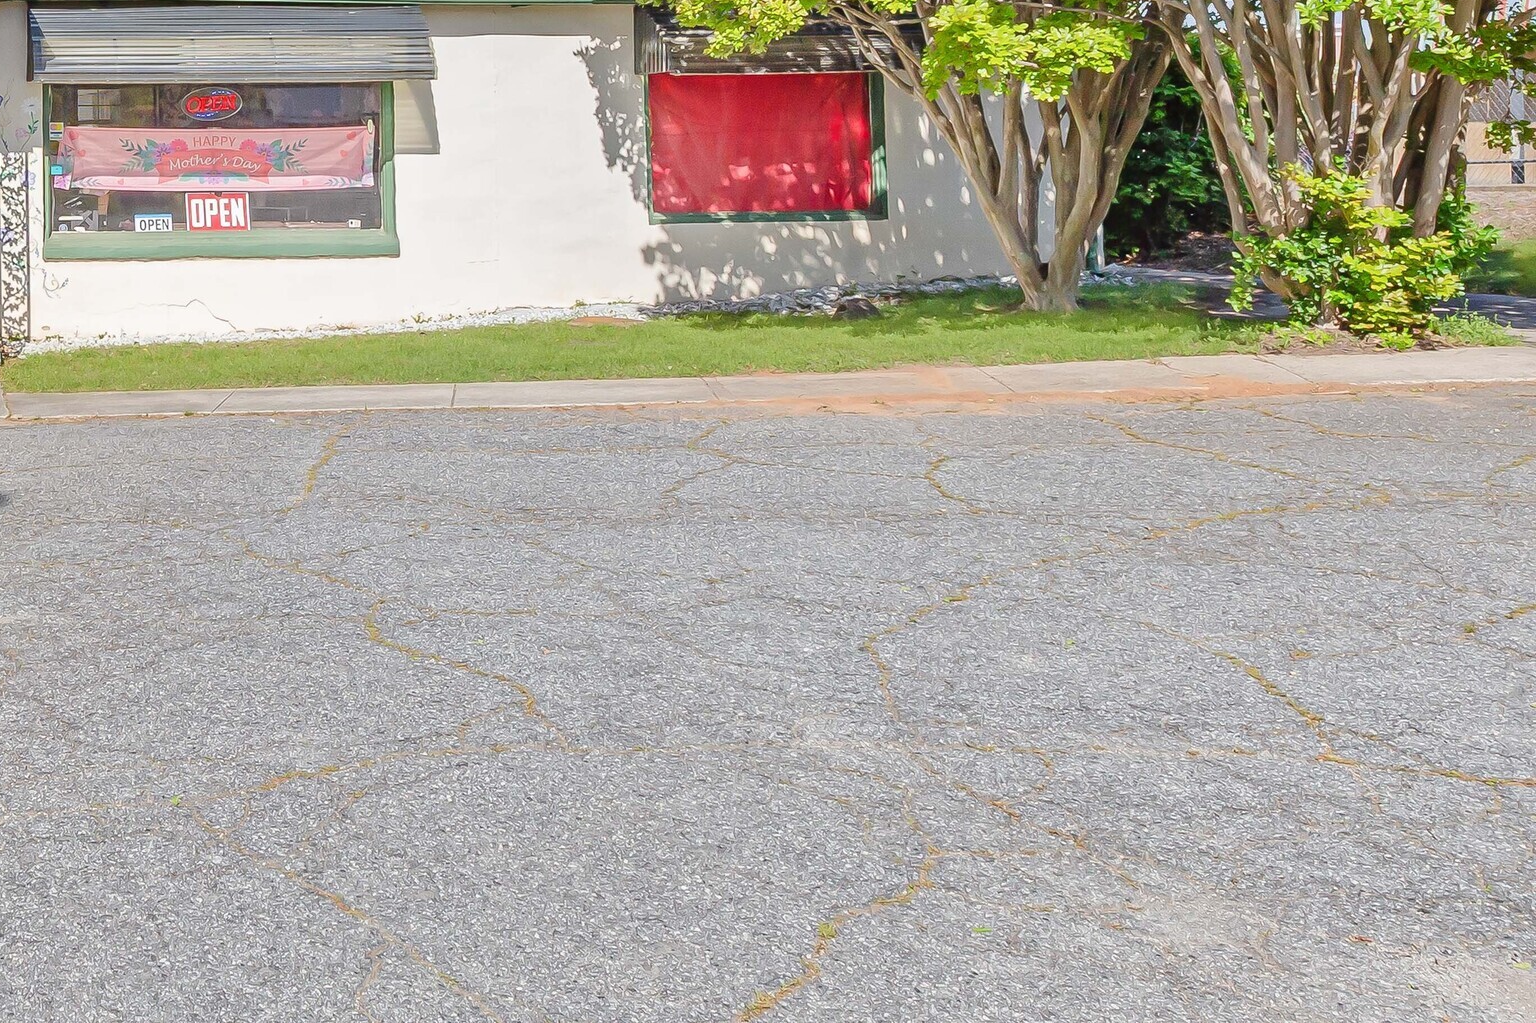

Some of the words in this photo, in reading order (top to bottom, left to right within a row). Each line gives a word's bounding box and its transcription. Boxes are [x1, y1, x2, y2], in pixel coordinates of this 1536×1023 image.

[186, 94, 237, 114] OPEN
[193, 136, 237, 147] HAPPY
[169, 153, 230, 171] Mother's
[232, 156, 262, 173] Day
[190, 198, 246, 228] OPEN
[139, 218, 170, 231] OPEN
